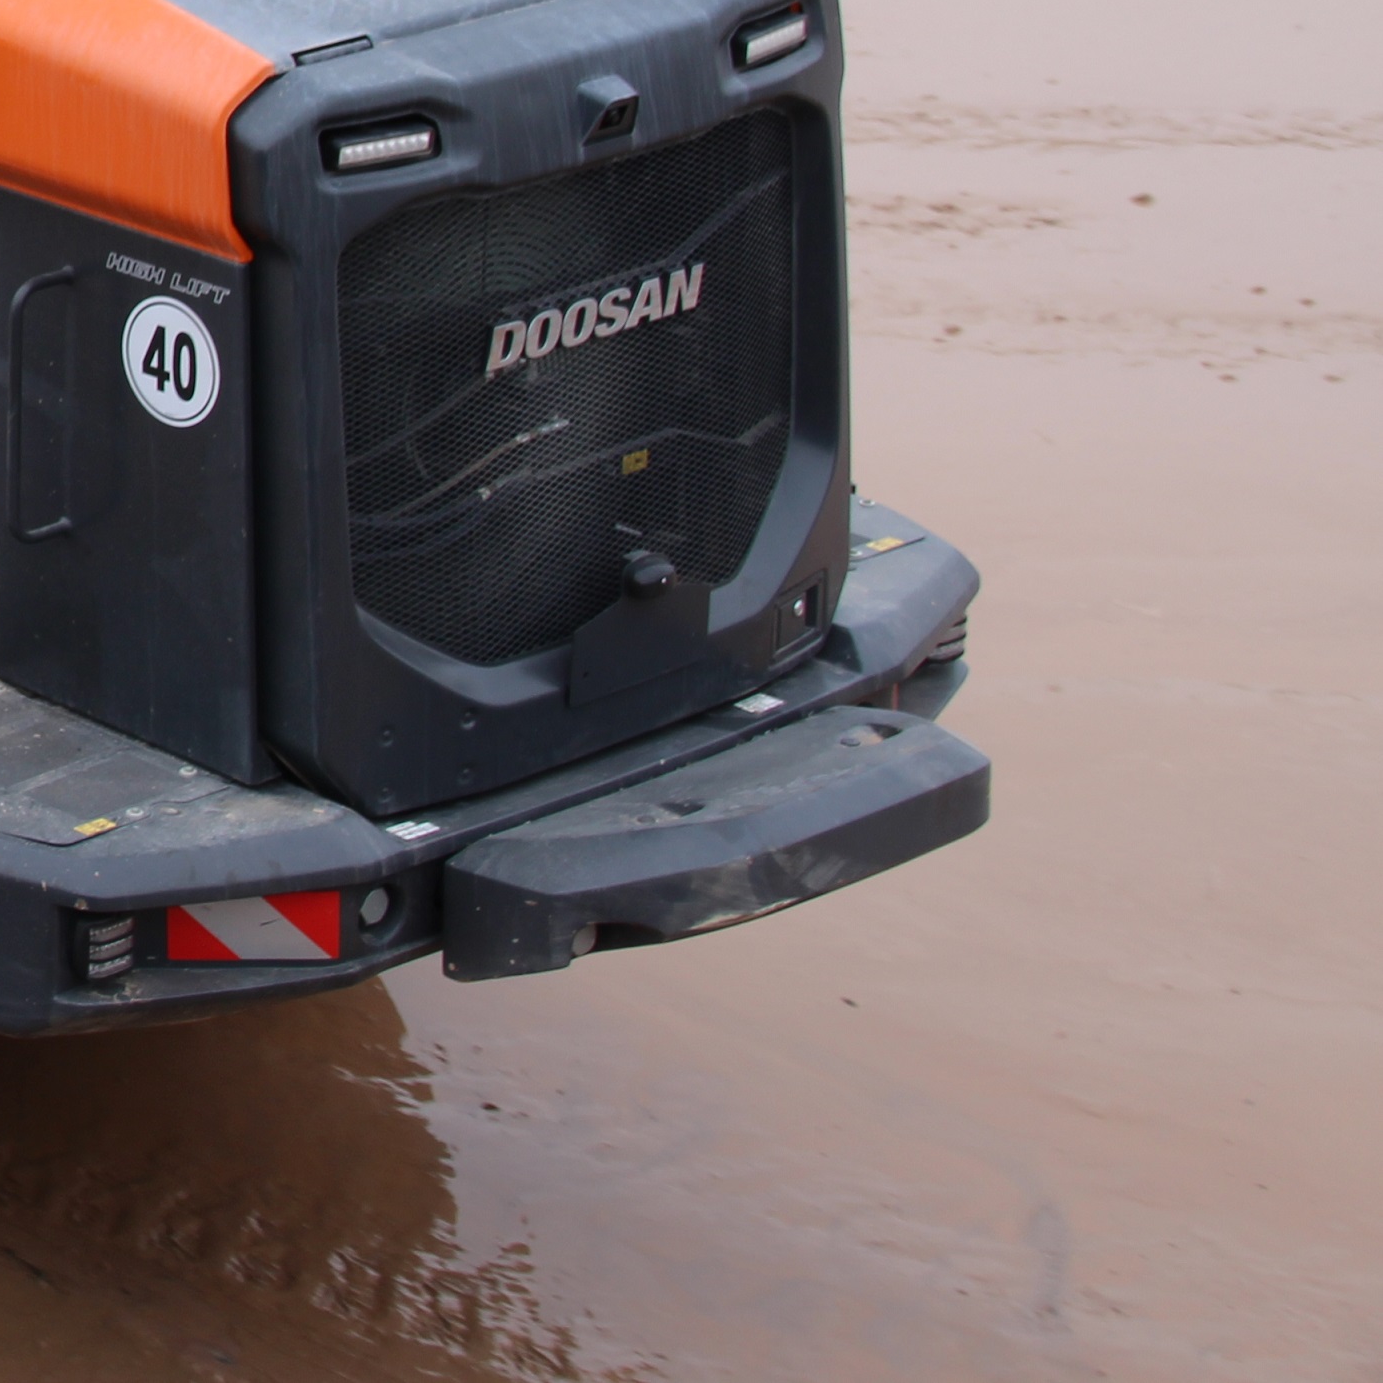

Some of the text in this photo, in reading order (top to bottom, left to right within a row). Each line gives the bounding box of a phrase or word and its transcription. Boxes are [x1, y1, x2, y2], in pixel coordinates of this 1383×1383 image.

[106, 251, 231, 305] HIGH LIFT
[486, 262, 704, 372] DOOSAN
[142, 324, 197, 402] 40
